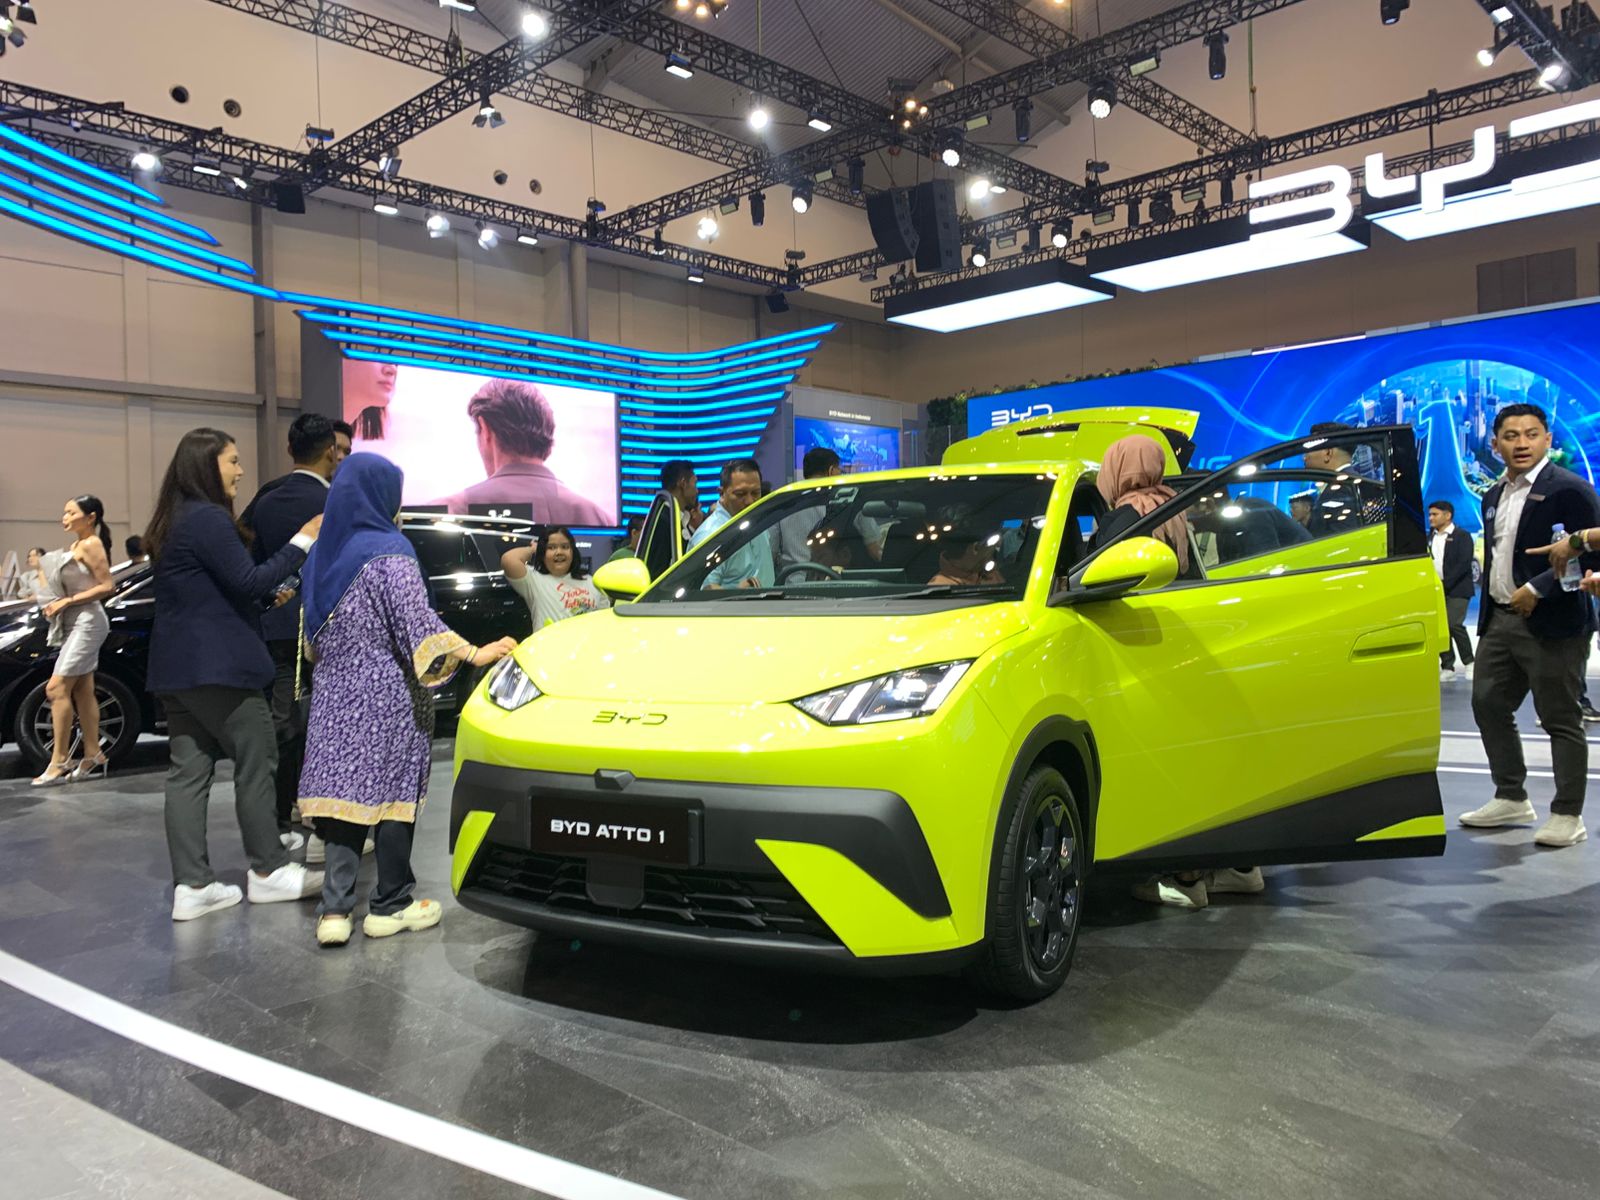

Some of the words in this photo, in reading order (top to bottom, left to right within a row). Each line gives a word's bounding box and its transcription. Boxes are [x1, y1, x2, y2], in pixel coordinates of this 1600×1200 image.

[592, 711, 668, 726] BYD
[550, 819, 590, 836] BYD
[595, 824, 651, 842] ATTO
[658, 830, 665, 844] 1
